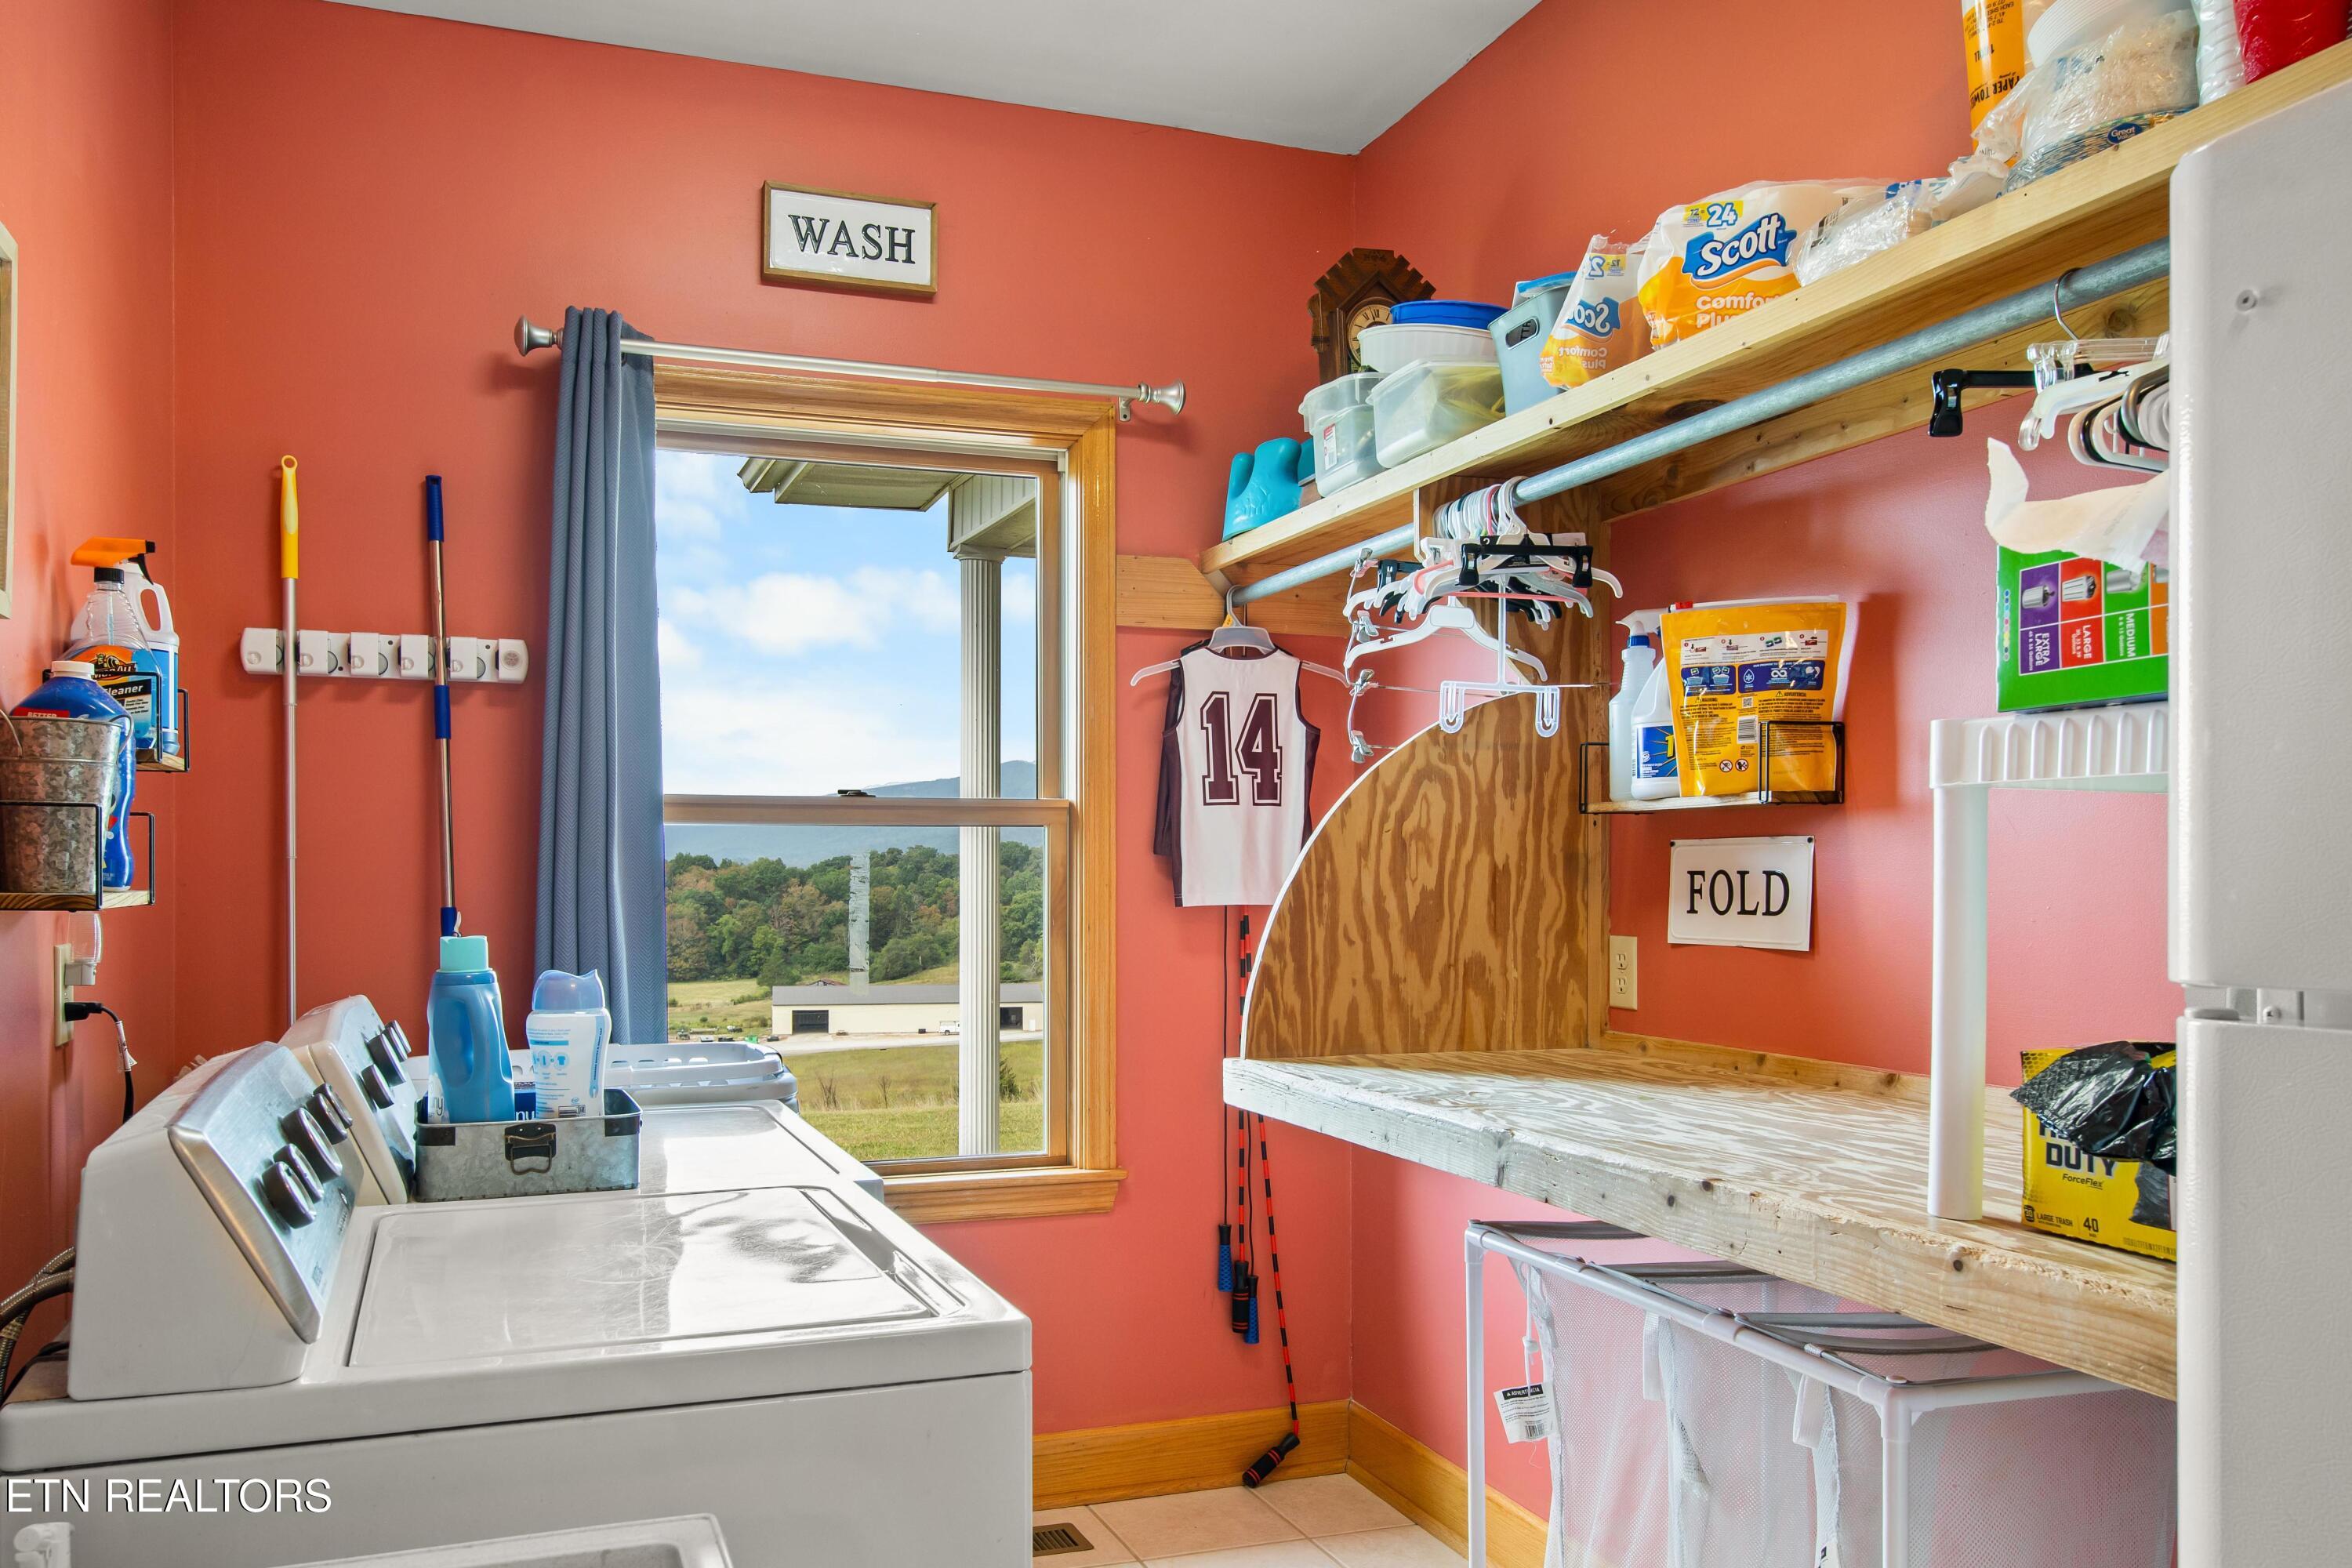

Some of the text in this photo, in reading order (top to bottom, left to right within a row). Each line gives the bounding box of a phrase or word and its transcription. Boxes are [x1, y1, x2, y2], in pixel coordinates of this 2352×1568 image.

[1970, 85, 1991, 109] TOWE
[2111, 125, 2136, 138] Great
[1690, 208, 1700, 216] 12
[1707, 202, 1738, 228] 24
[788, 214, 916, 264] WASH
[1696, 212, 1782, 277] Scott
[2034, 633, 2044, 666] LARGE
[2042, 632, 2051, 665] EXTRA
[2082, 624, 2092, 659] LARGE
[2125, 612, 2136, 658] MEDIUM
[1200, 691, 1283, 807] 14
[1686, 869, 1790, 916] FOLD
[2045, 1142, 2116, 1177] DUTY
[2062, 1173, 2104, 1188] ForceFlex
[2036, 1212, 2054, 1223] LARGE
[2055, 1216, 2074, 1227] TRASH
[2083, 1216, 2099, 1232] 40
